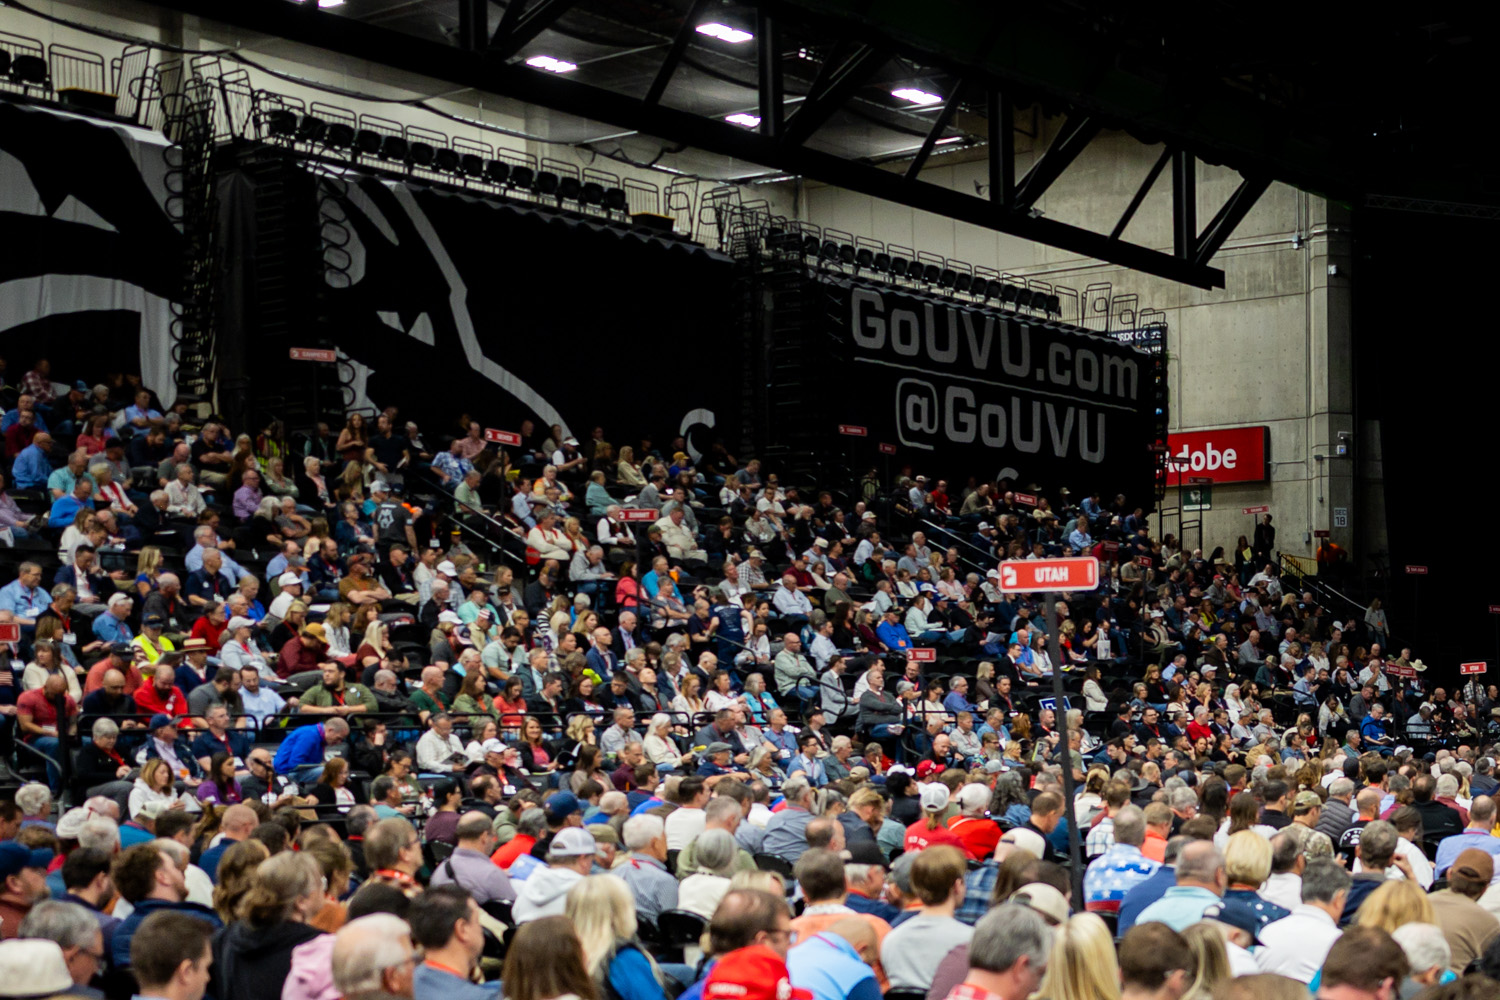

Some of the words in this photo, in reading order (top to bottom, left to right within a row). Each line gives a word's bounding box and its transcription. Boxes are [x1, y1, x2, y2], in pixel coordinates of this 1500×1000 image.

[852, 287, 1138, 400] GoUVU.com
[896, 378, 1105, 463] @GoUVU
[1034, 566, 1069, 582] UTAH
